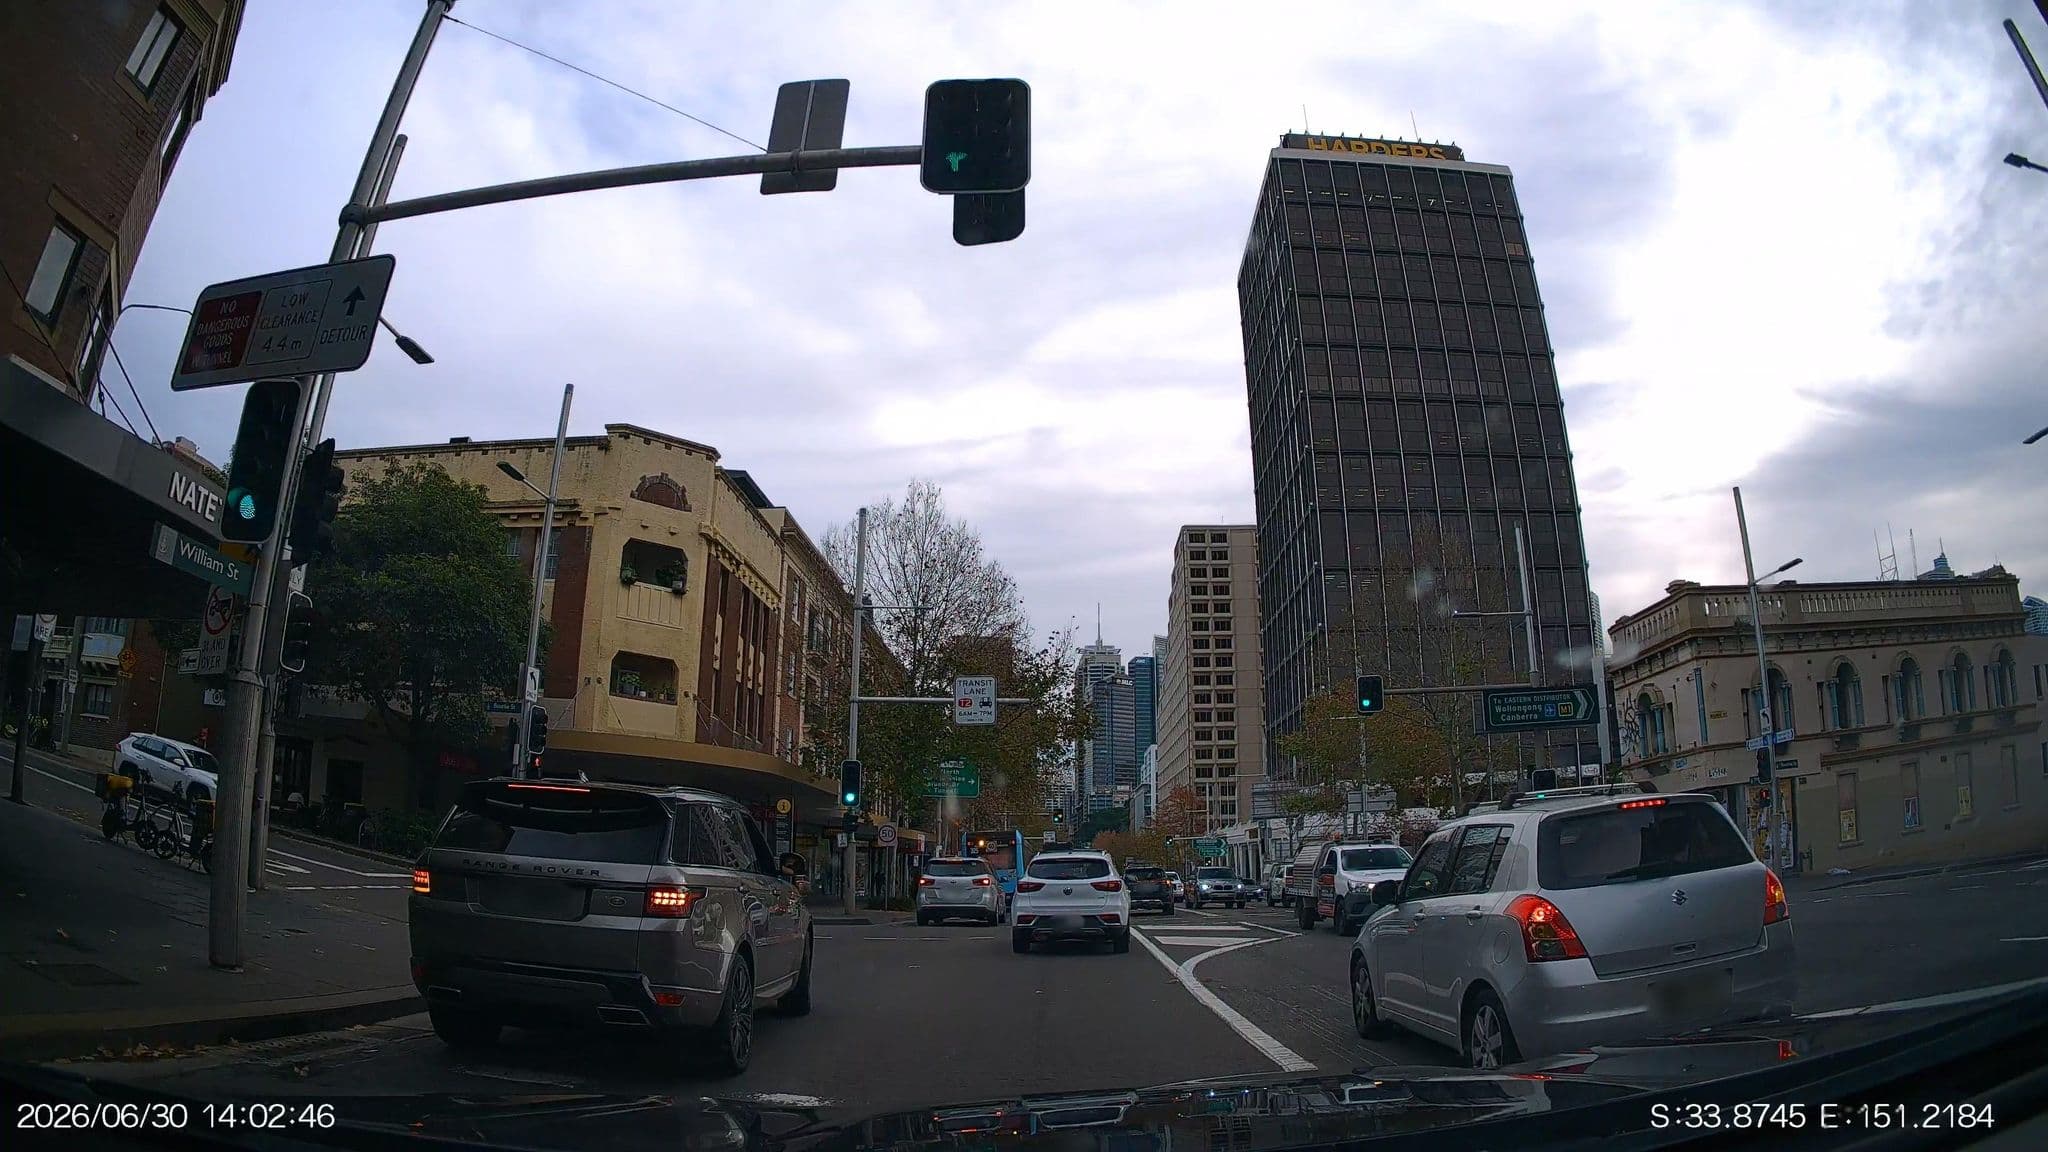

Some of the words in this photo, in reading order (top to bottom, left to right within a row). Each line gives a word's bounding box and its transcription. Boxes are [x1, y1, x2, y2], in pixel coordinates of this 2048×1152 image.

[220, 300, 237, 315] NO
[281, 291, 309, 309] LOW
[197, 315, 249, 336] DANGEROUS
[260, 310, 319, 330] CLEARANCE
[203, 332, 233, 349] GOODS
[320, 324, 368, 345] DETOUR
[179, 538, 224, 575] William
[226, 562, 240, 581] St
[960, 699, 971, 707] T2
[1533, 694, 1571, 702] DISTRIBUTOR
[1494, 703, 1542, 713] Wollongong
[1560, 705, 1572, 714] M1
[1500, 713, 1538, 721] Canberra
[881, 829, 894, 838] 50
[463, 858, 521, 871] RANGE
[533, 865, 602, 877] ROVER
